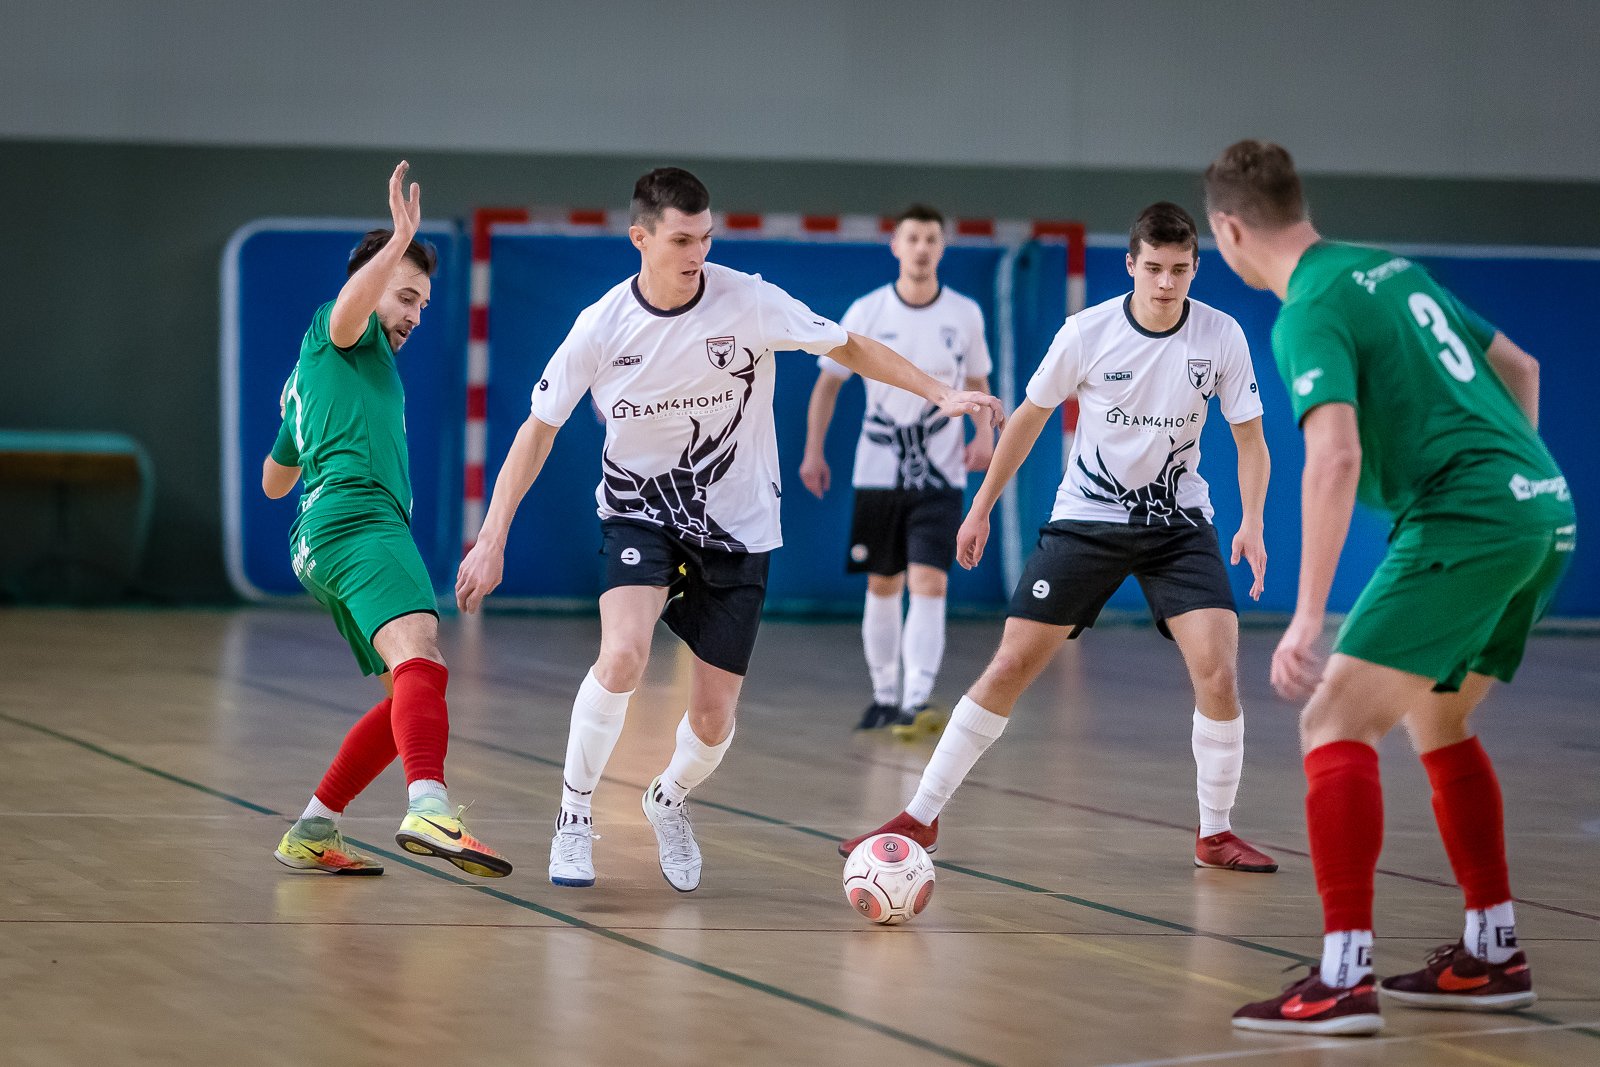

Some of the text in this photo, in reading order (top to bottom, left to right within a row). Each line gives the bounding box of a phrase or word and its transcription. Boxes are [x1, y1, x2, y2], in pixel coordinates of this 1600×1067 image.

[1408, 292, 1476, 382] 3
[612, 389, 734, 419] TEAM4HOME
[1106, 407, 1199, 428] TEAM4HOE
